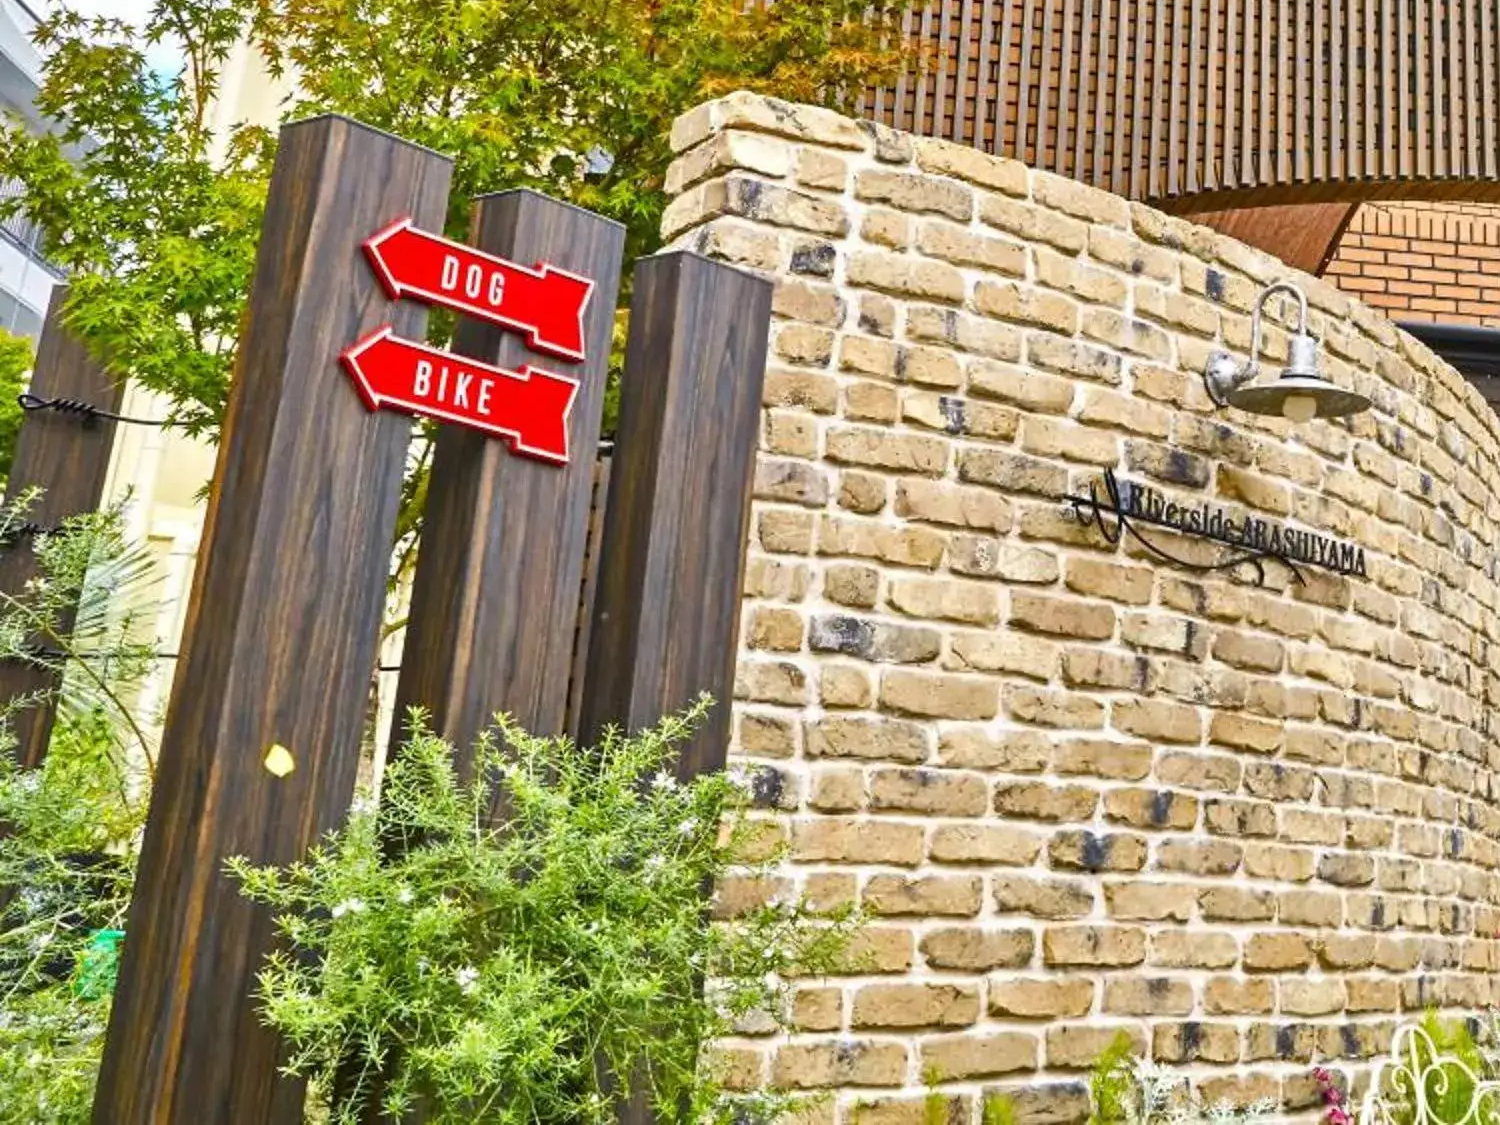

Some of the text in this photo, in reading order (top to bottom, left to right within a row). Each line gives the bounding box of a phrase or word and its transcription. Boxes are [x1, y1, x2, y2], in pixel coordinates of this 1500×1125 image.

[441, 256, 505, 305] DOG
[413, 361, 494, 414] BIKE
[1128, 483, 1367, 576] Riverside ARASHIYAMA
